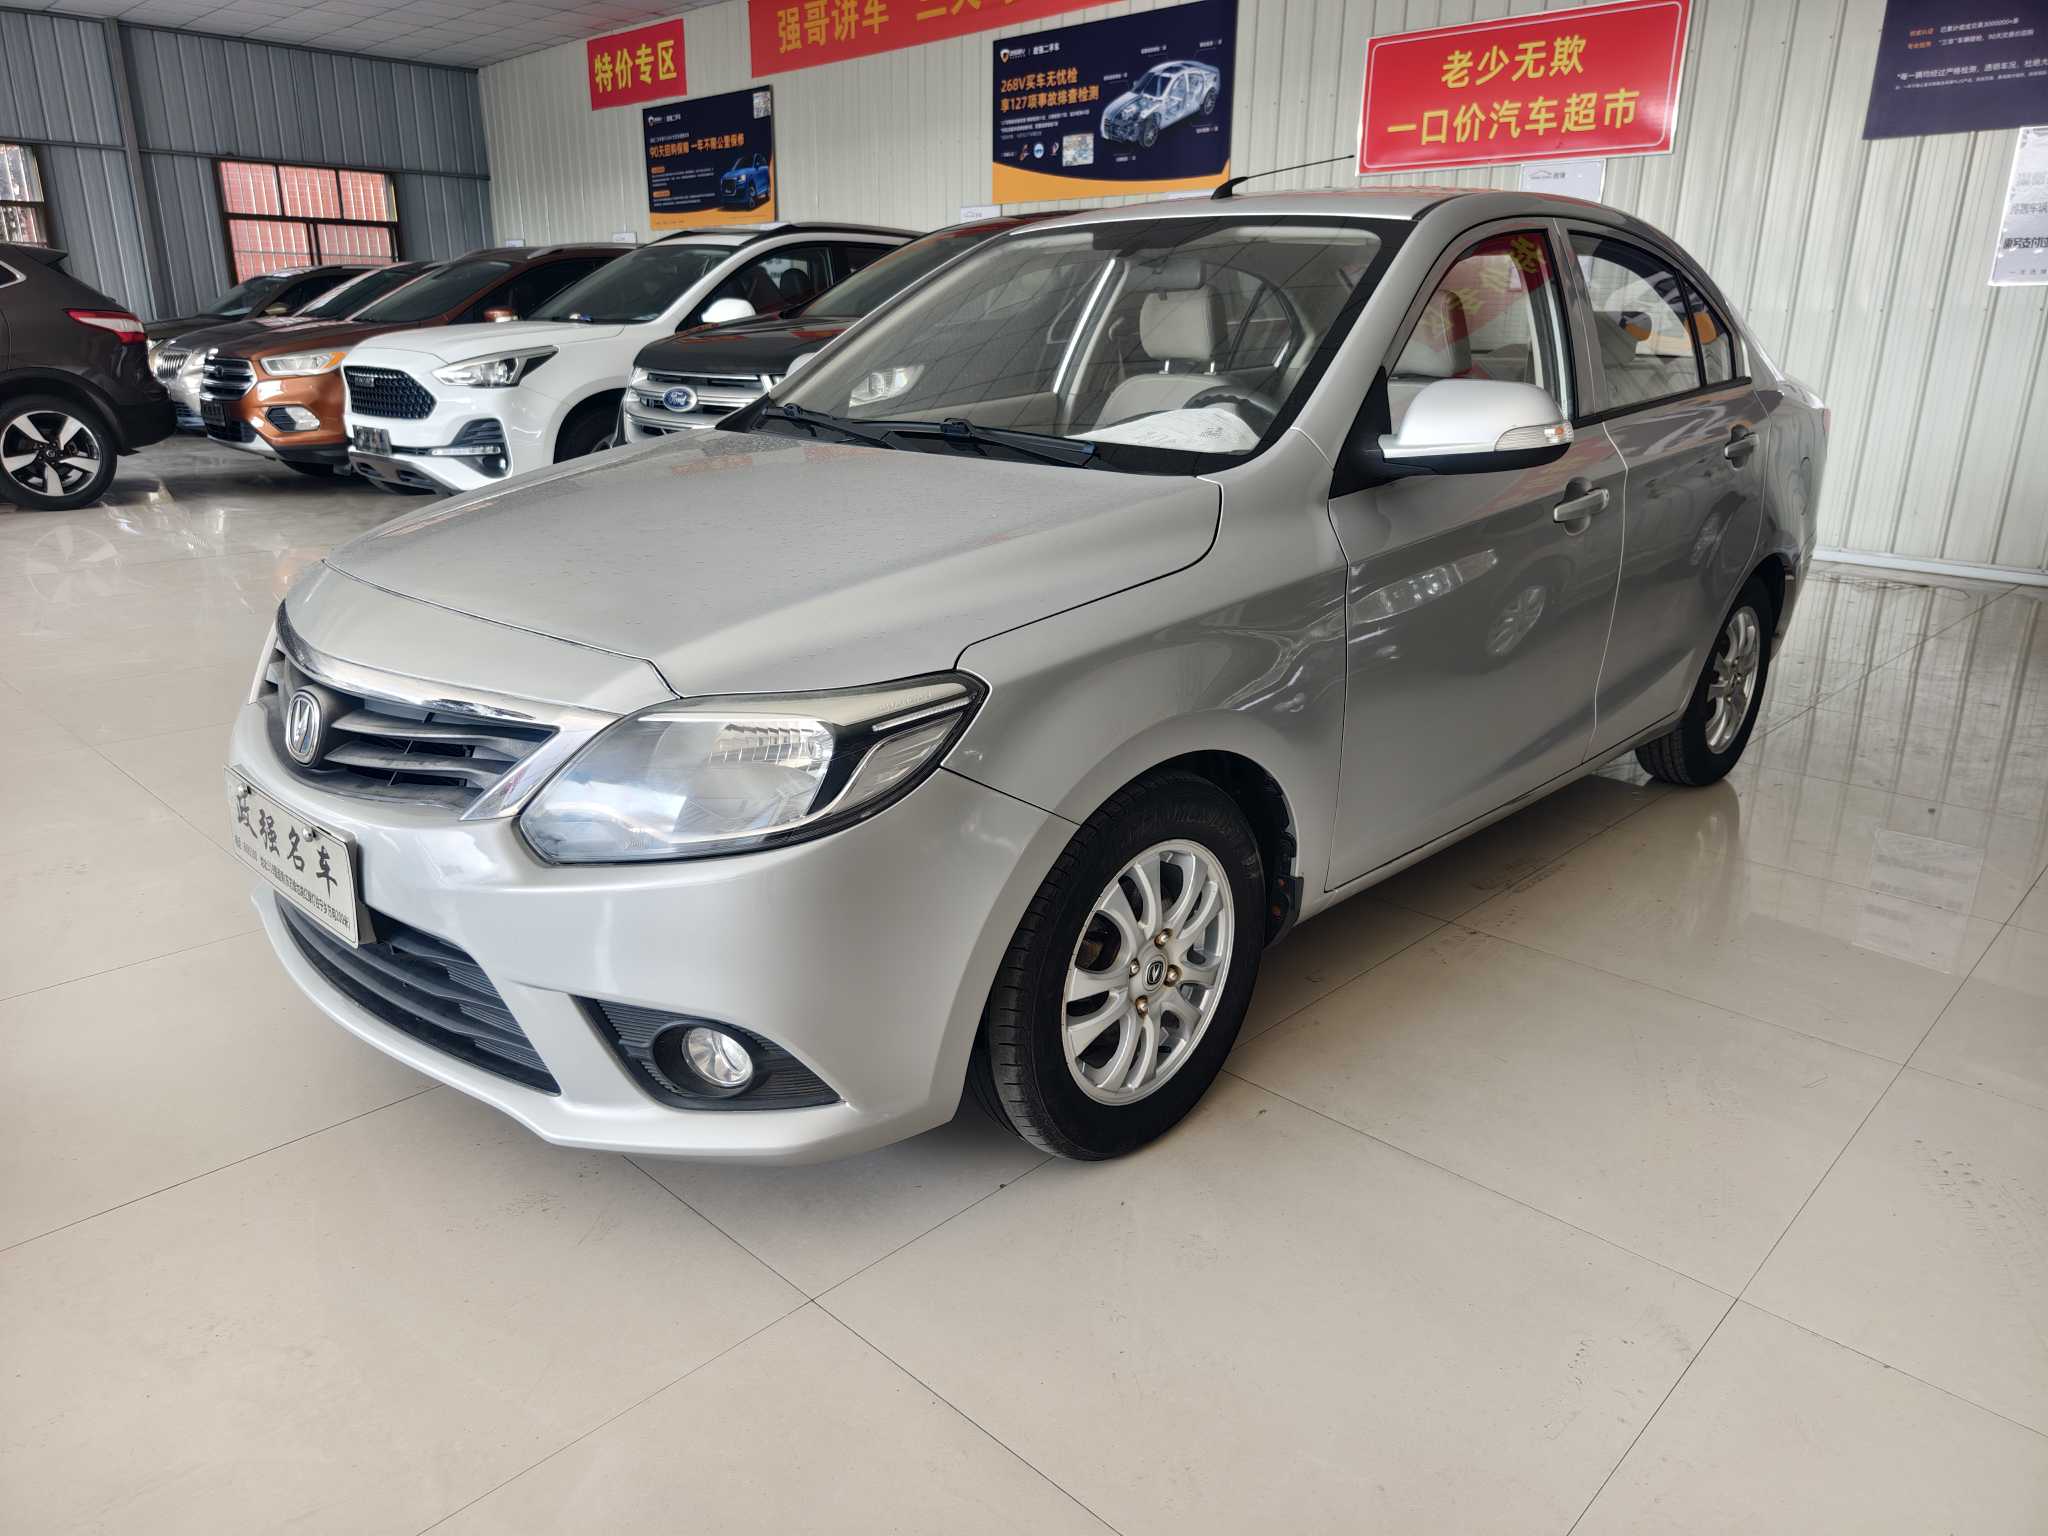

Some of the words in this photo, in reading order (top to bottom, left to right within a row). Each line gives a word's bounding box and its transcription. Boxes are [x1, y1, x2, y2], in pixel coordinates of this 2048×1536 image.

[777, 0, 890, 54] 强哥讲车
[594, 40, 678, 93] 特价专区
[1441, 34, 1586, 89] 老少无欺
[1387, 88, 1640, 145] 一口价汽车超市
